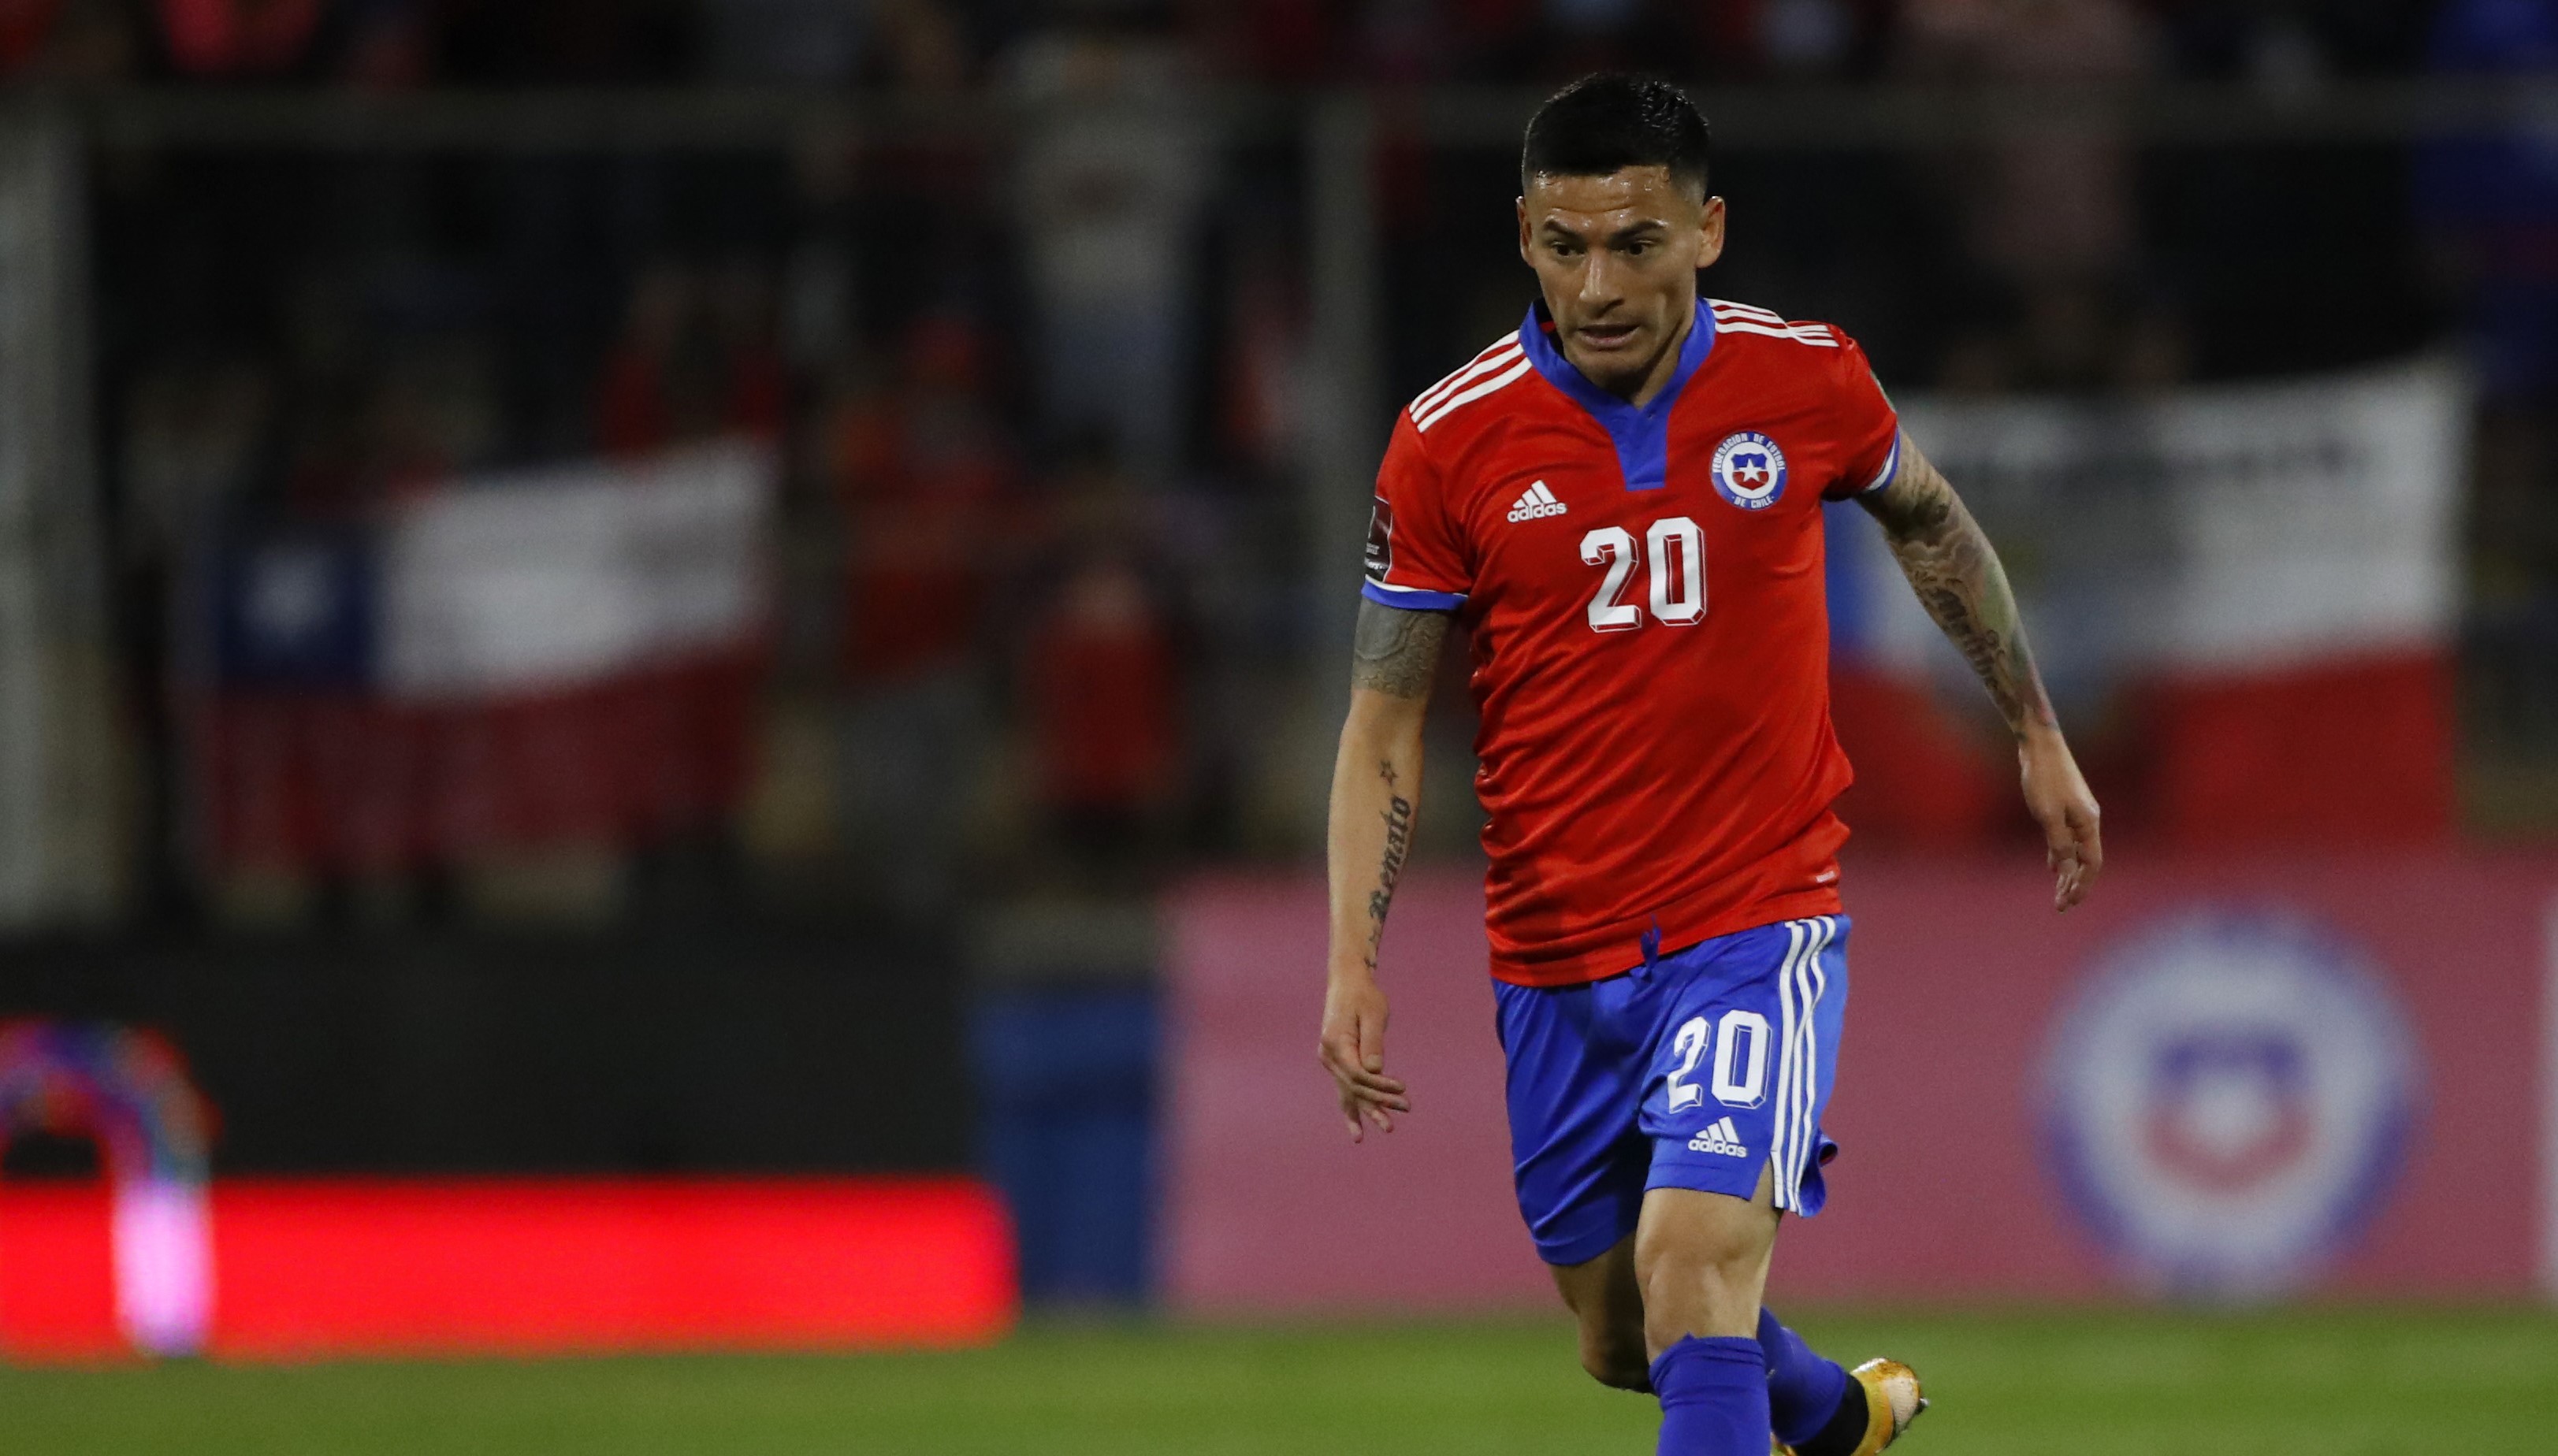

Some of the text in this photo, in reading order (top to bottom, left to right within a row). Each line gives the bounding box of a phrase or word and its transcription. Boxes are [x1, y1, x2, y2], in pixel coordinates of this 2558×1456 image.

[1753, 434, 1764, 443] DE
[1734, 496, 1773, 508] DE CHILE
[1508, 503, 1567, 522] adidas
[1579, 517, 1707, 633] 20
[1369, 796, 1411, 921] Renato
[1667, 1010, 1772, 1114] 20
[1688, 1138, 1748, 1157] adidas
